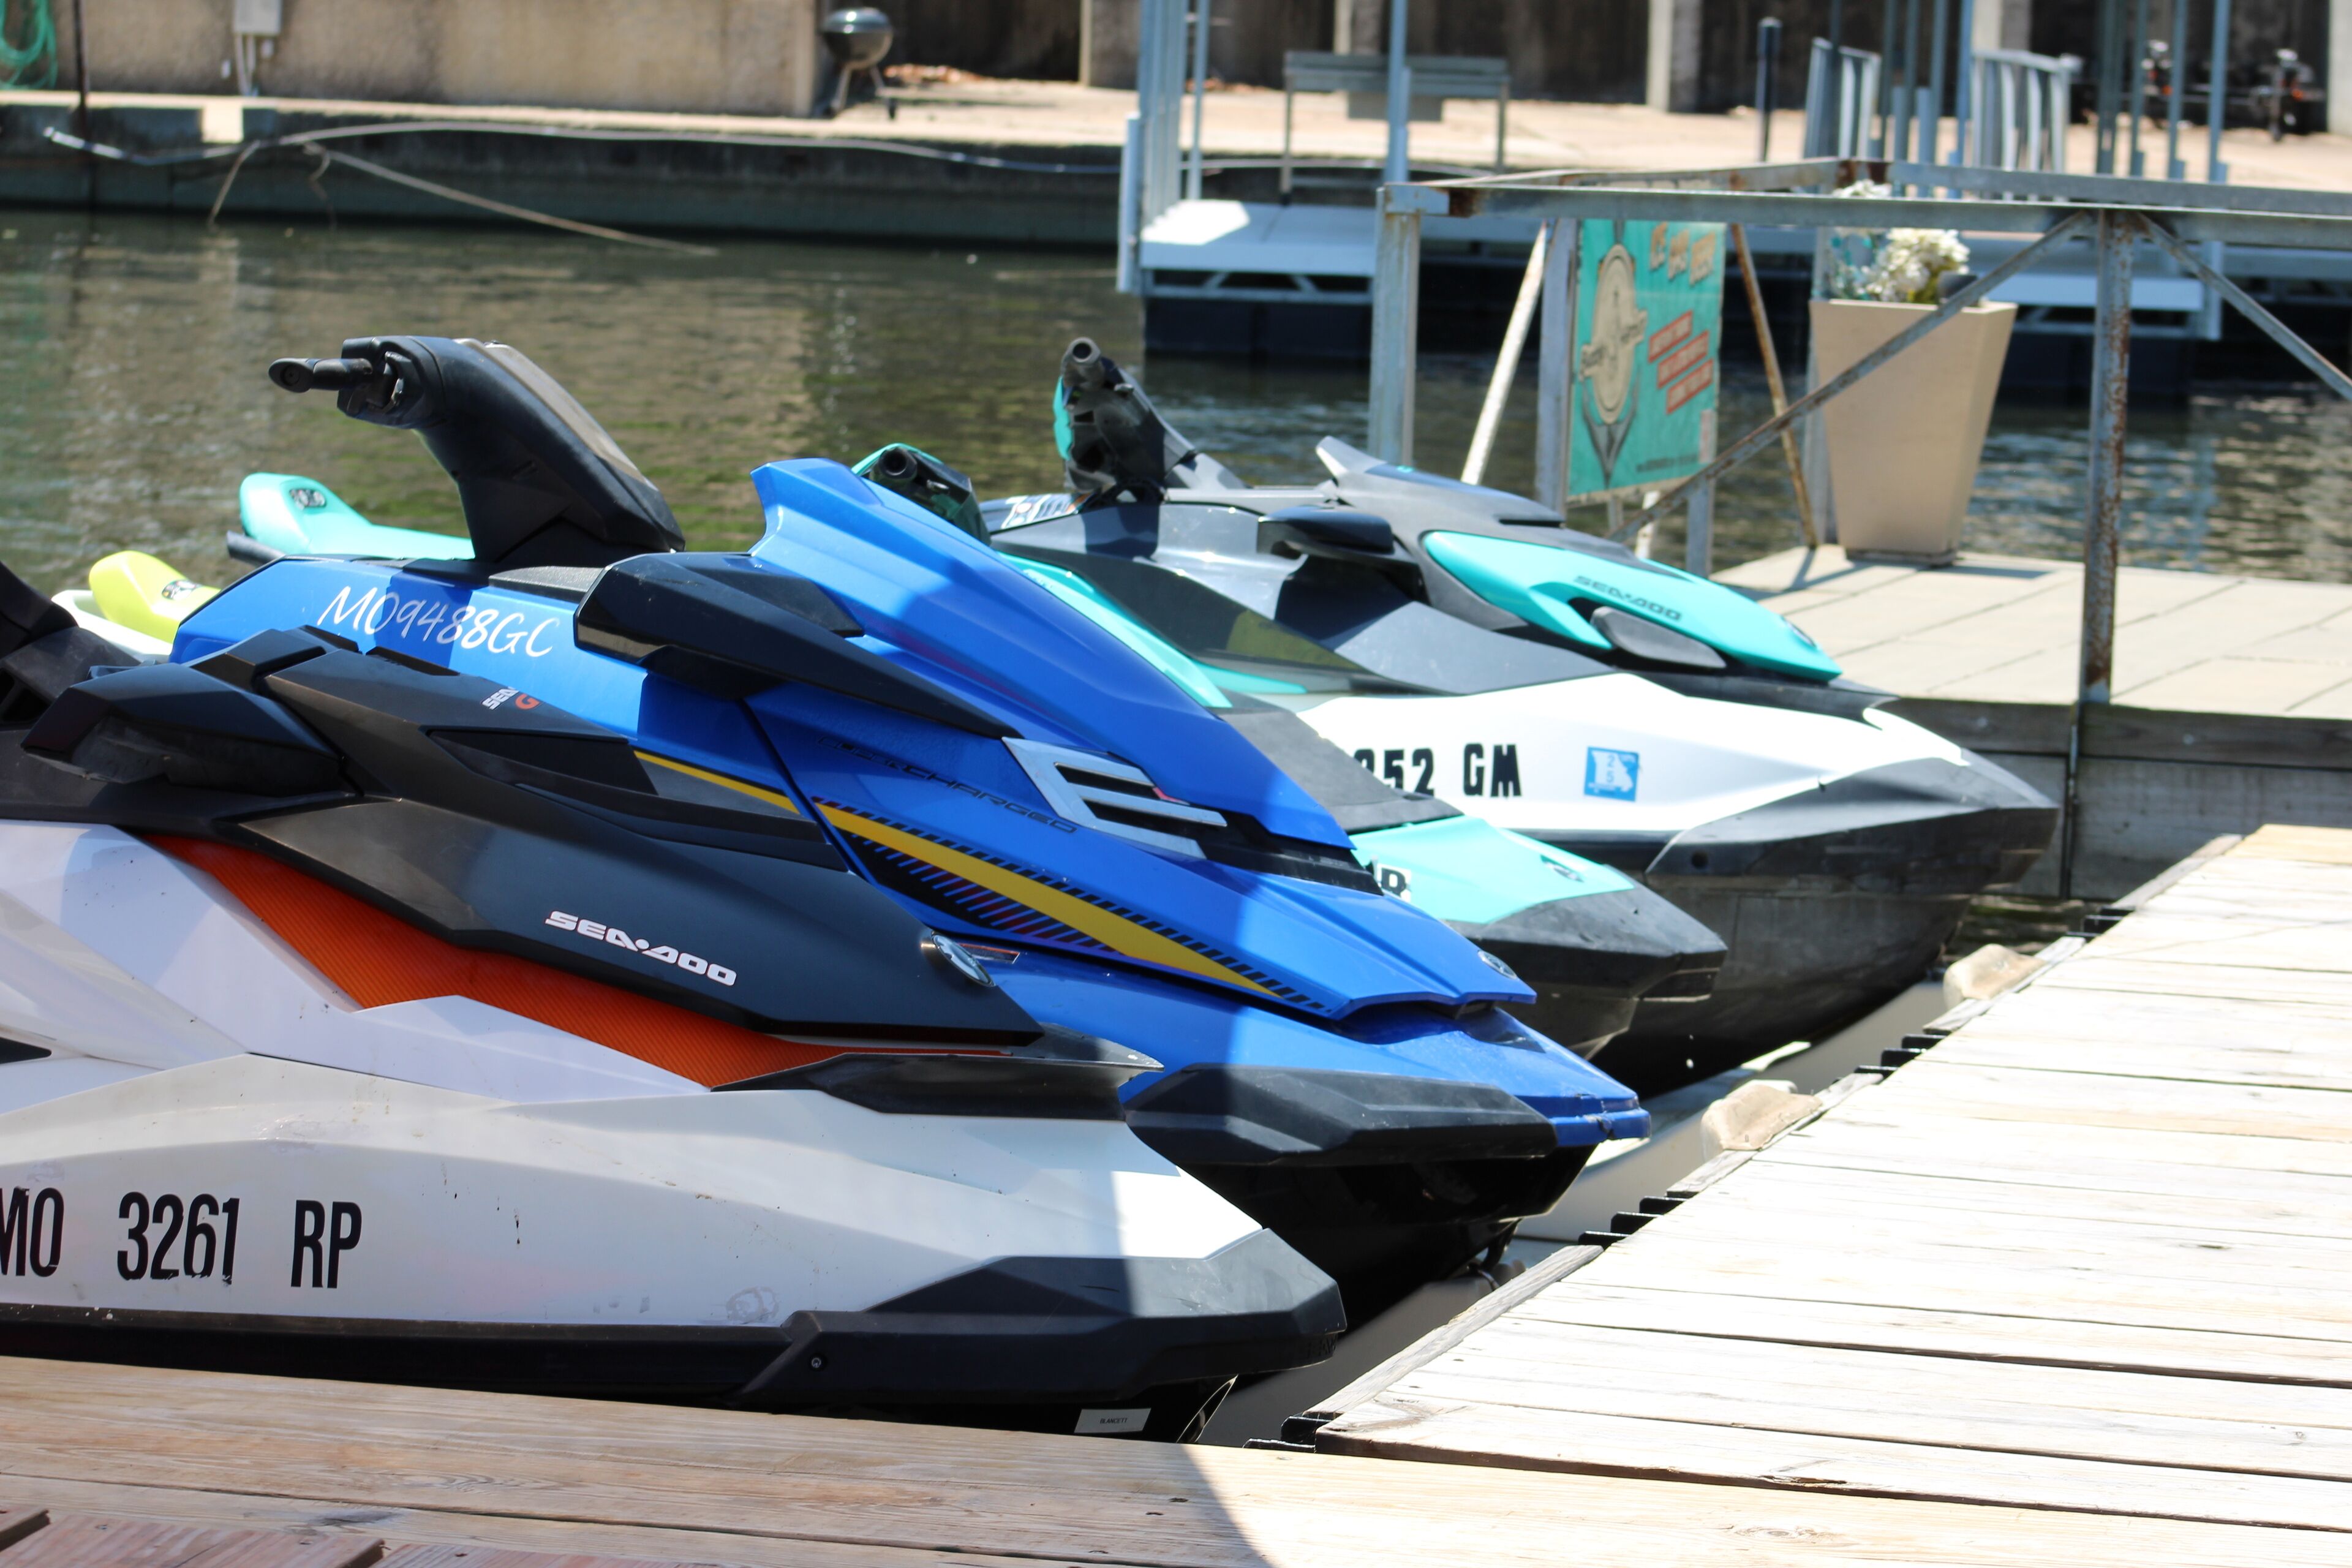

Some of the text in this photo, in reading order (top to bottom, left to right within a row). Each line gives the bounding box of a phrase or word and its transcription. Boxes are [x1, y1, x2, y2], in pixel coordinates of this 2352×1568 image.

[1463, 743, 1522, 799] GM
[117, 1191, 240, 1285] 3261
[290, 1199, 363, 1289] RP
